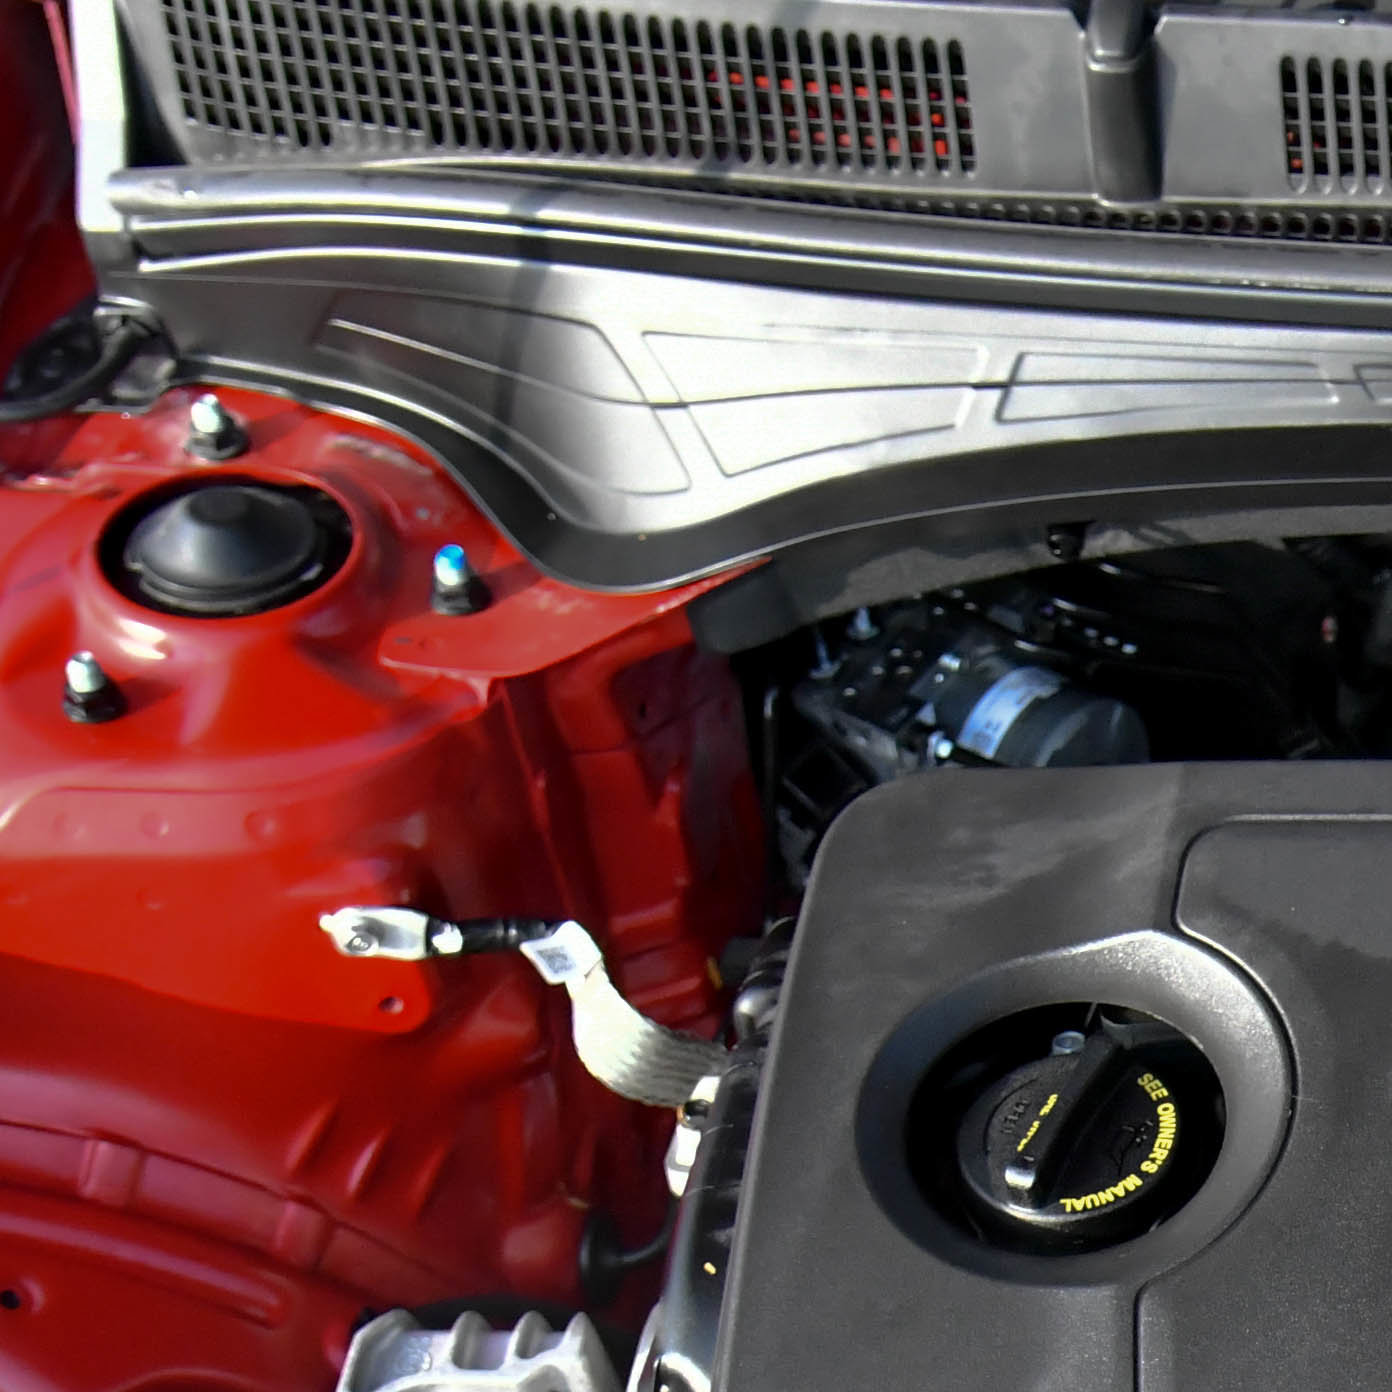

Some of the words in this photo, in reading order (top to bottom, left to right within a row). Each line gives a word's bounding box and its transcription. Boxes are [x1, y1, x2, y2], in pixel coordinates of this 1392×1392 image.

[1136, 1072, 1169, 1101] SEE
[1140, 1102, 1177, 1174] OWNER'S
[1059, 1173, 1143, 1213] MANUAL
